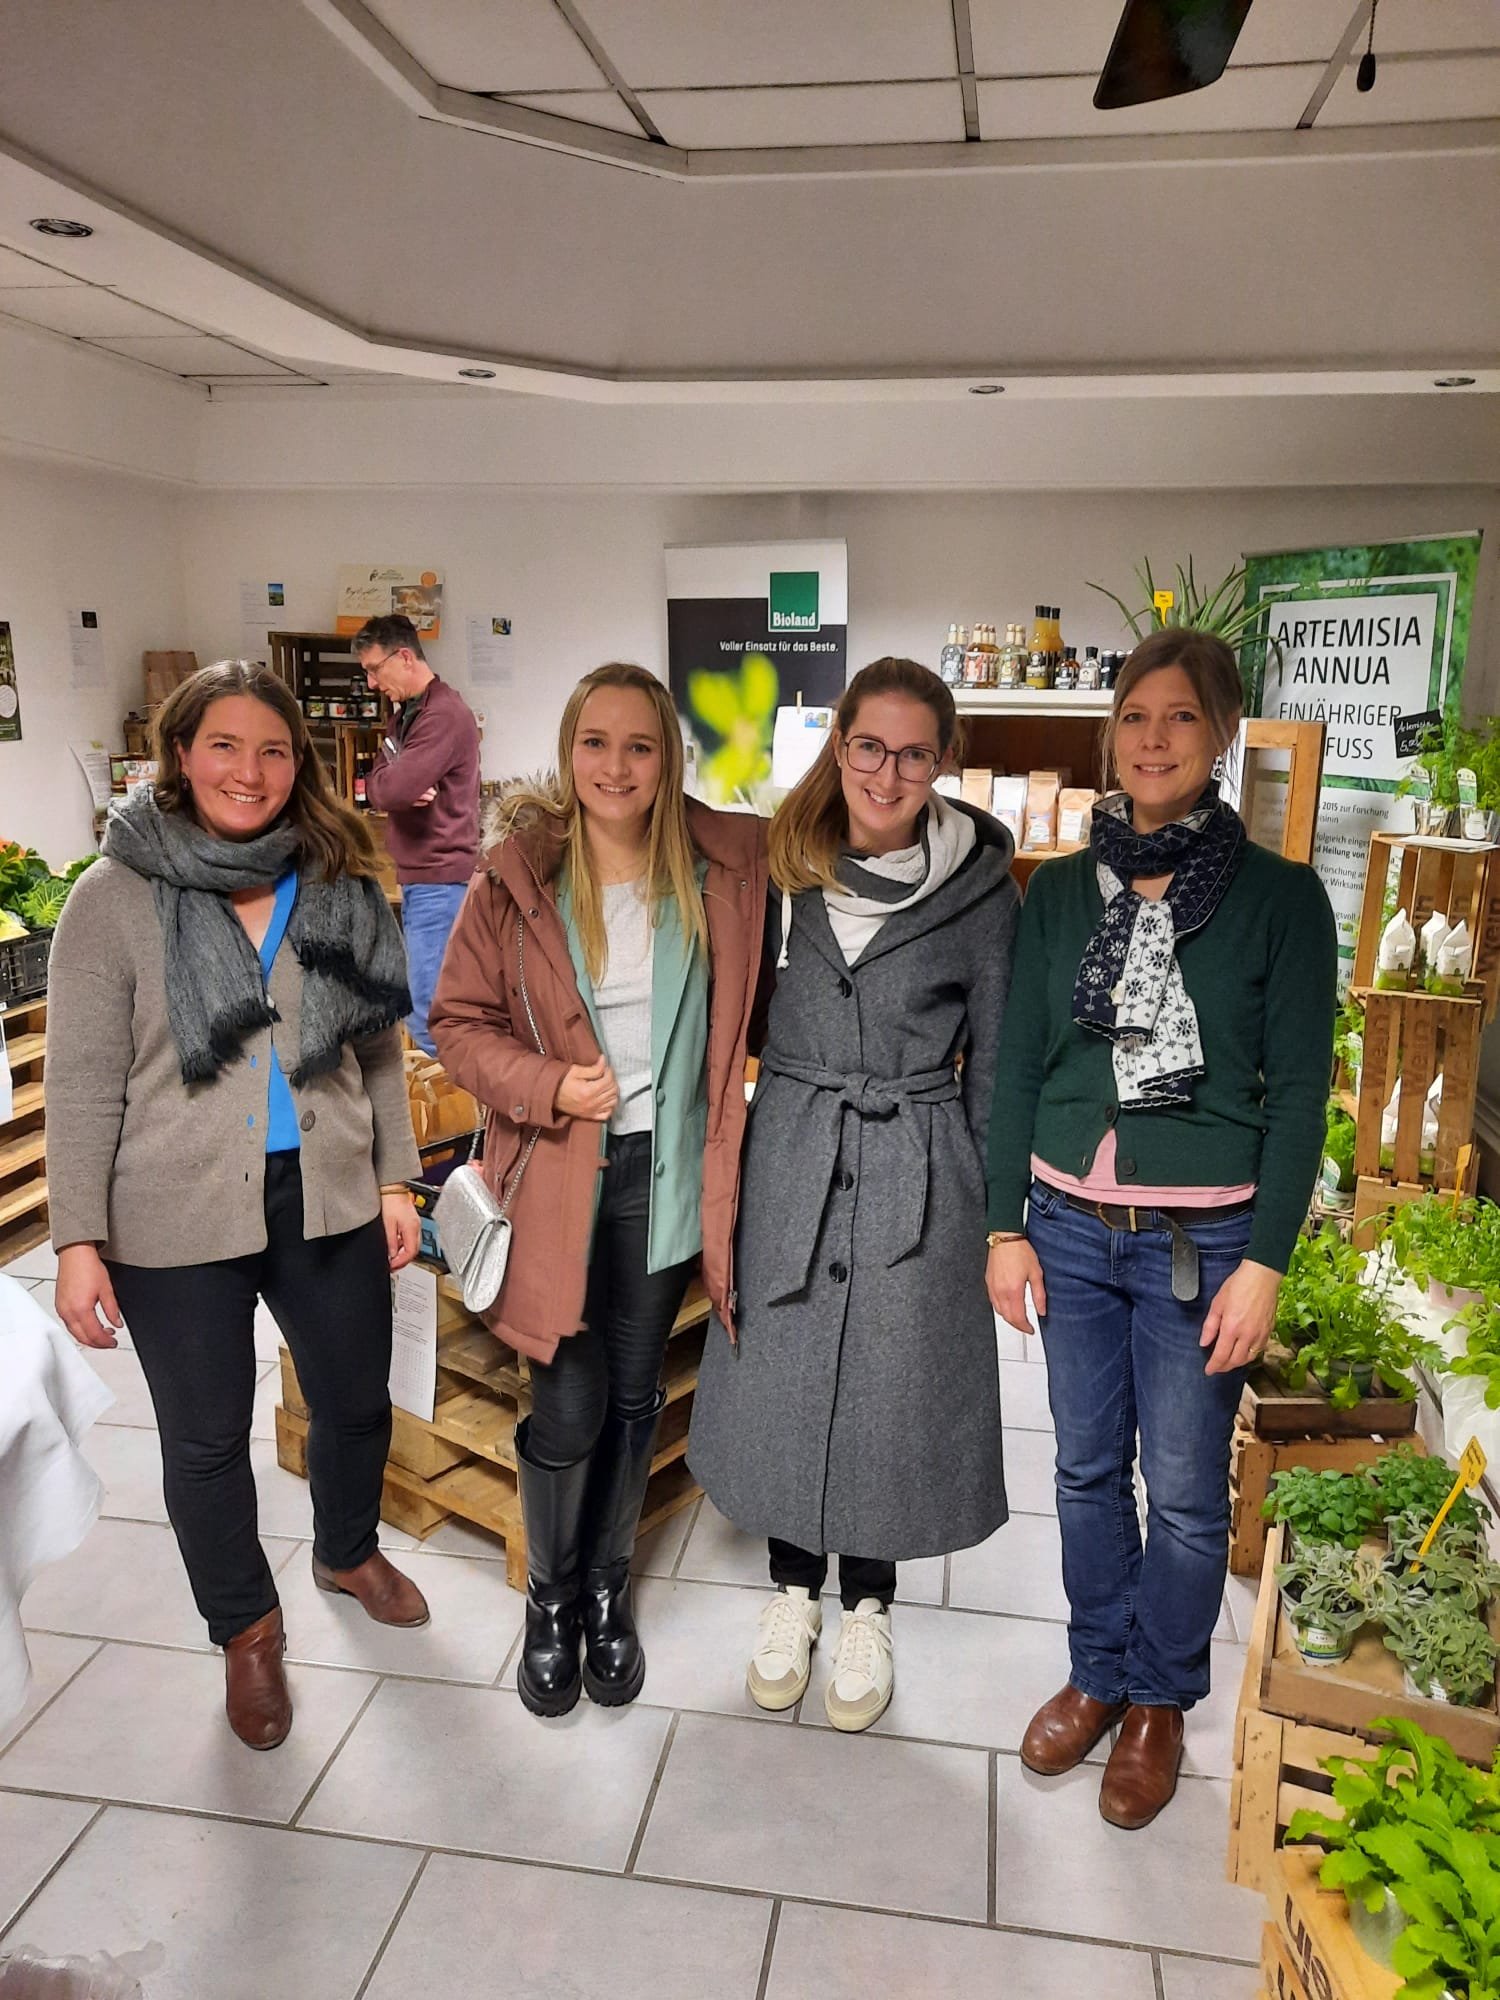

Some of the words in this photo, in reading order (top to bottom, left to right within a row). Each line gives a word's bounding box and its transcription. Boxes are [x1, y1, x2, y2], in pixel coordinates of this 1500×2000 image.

[772, 612, 816, 627] Bioland
[1275, 616, 1421, 649] ARTEMISIA
[720, 641, 744, 652] Voller
[745, 641, 777, 652] Einsatz
[779, 640, 791, 652] für
[793, 641, 809, 652] das
[810, 641, 839, 652] Beste.
[1293, 655, 1391, 686] ANNUA
[1325, 737, 1374, 760] FUSS
[1322, 801, 1338, 812] 2015
[1352, 804, 1390, 820] Forschung
[1316, 831, 1347, 845] folgreich
[1322, 845, 1350, 859] Heilung
